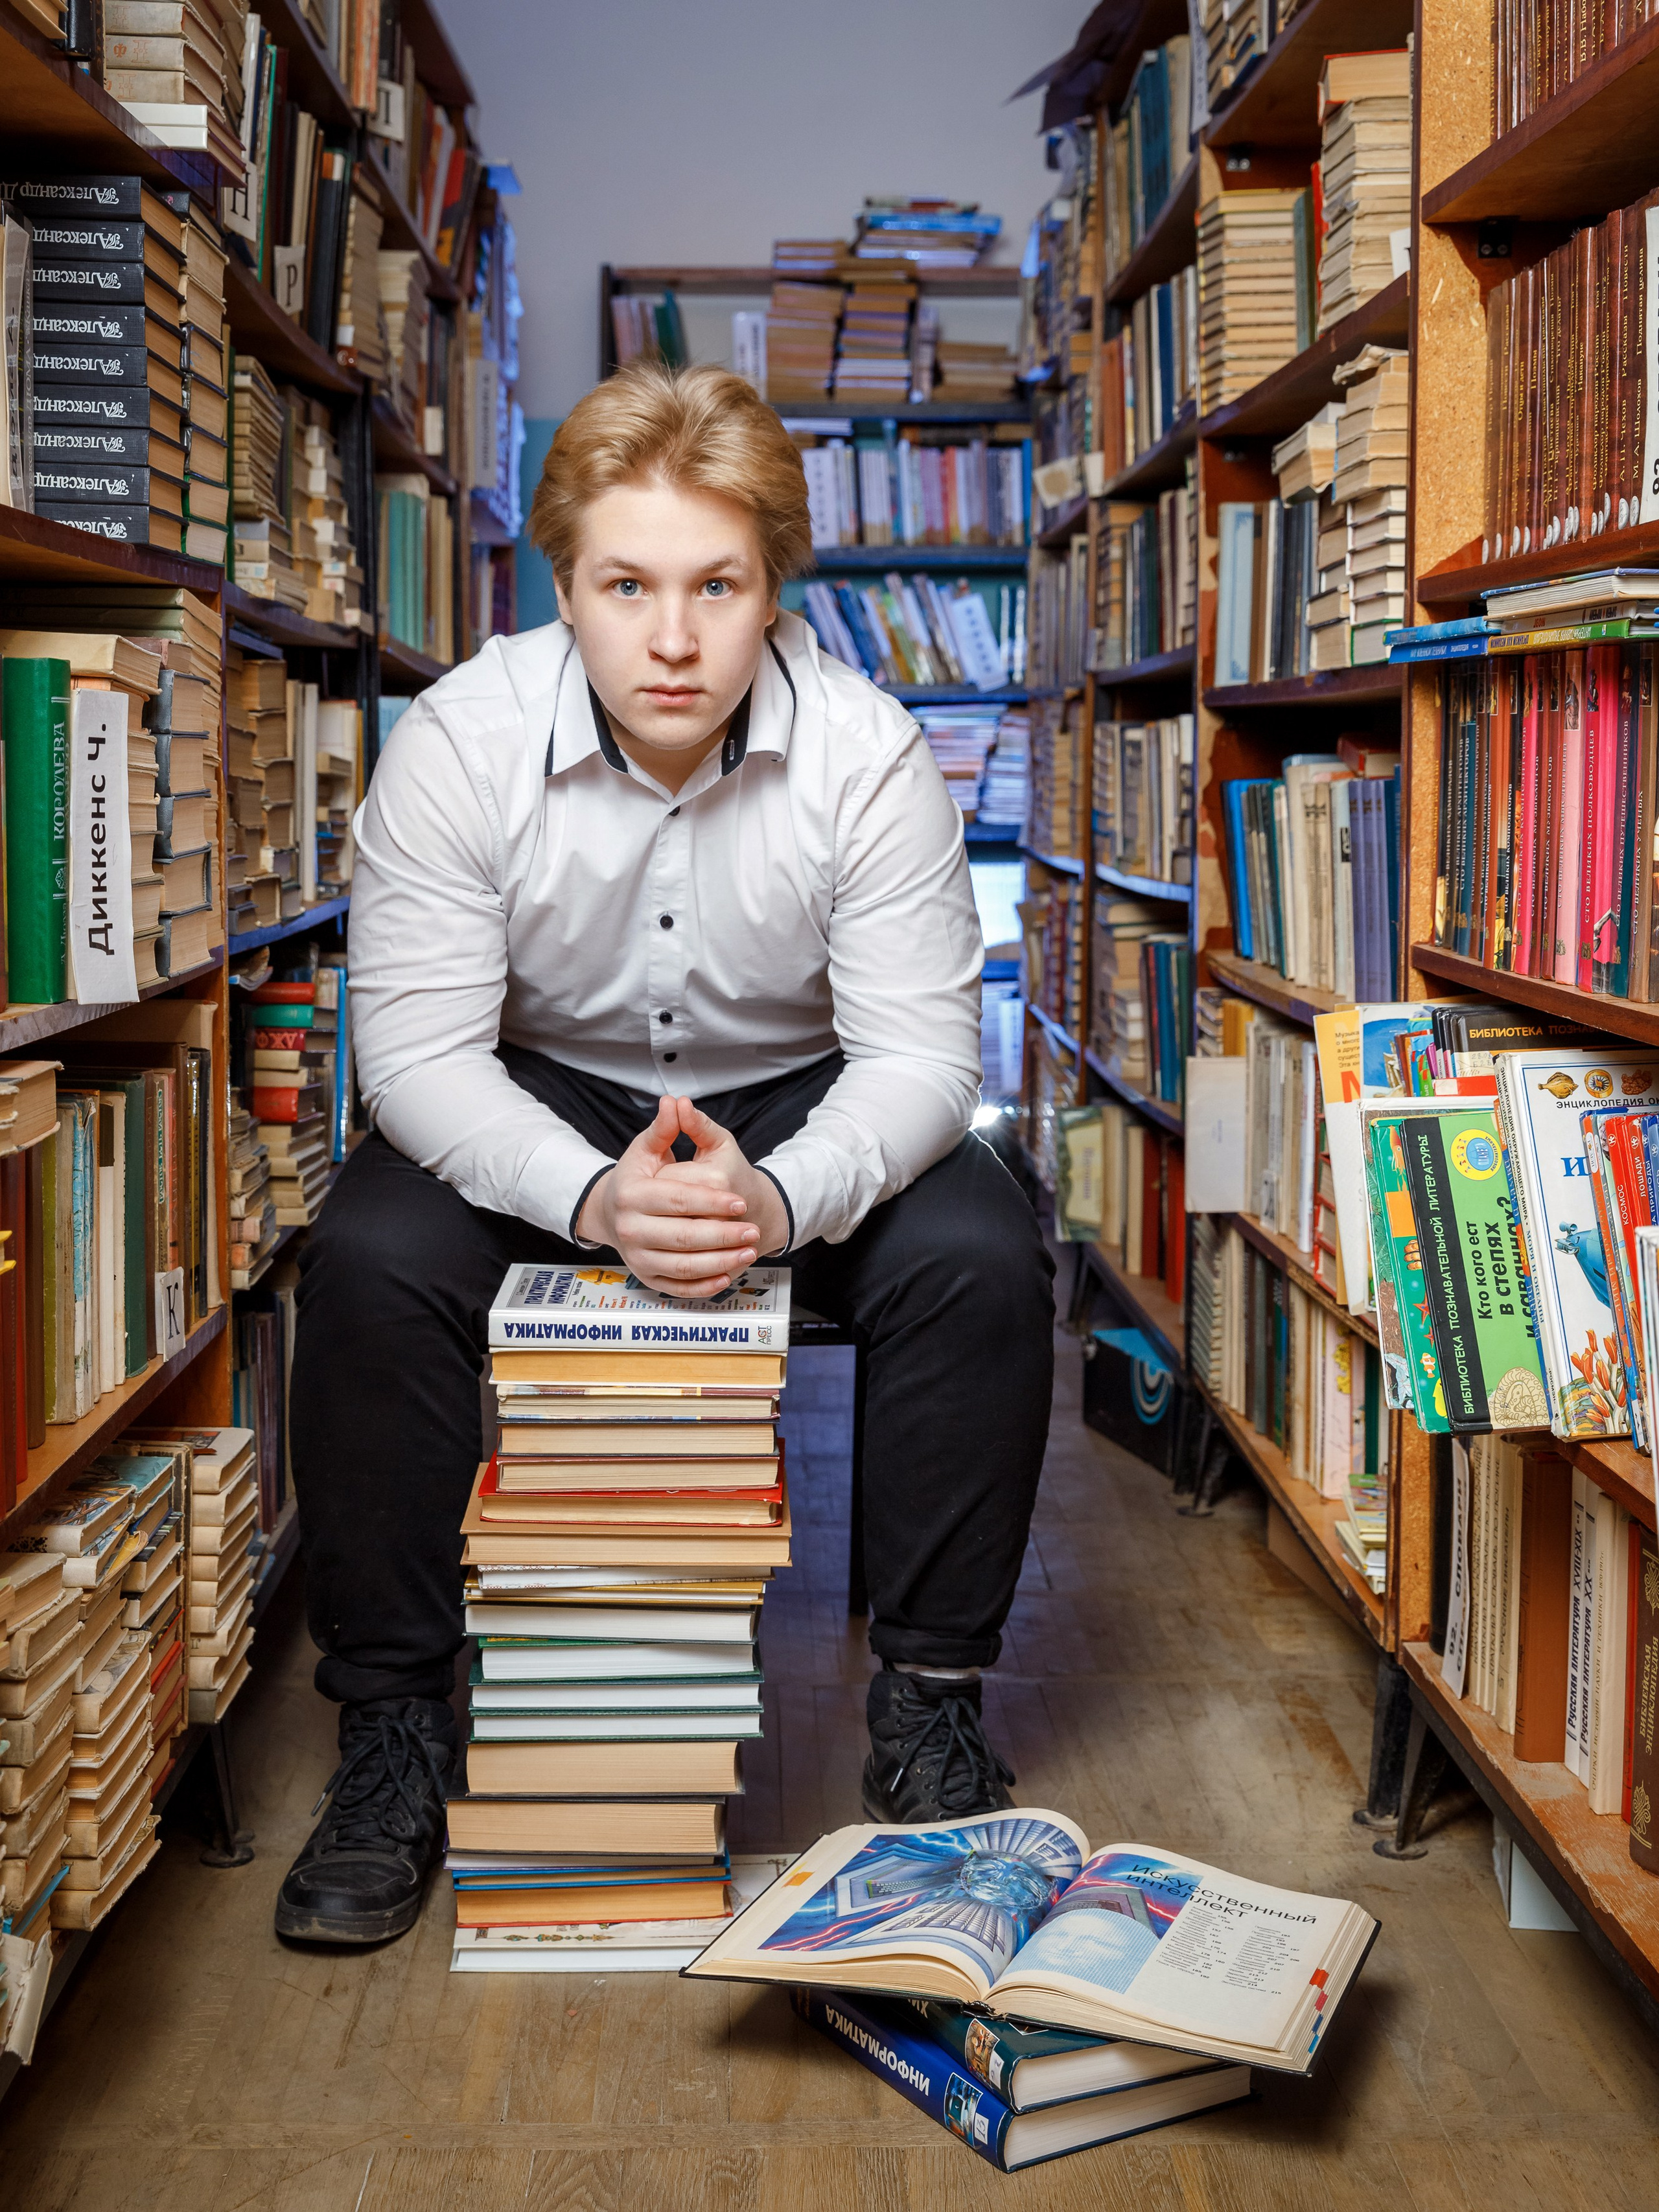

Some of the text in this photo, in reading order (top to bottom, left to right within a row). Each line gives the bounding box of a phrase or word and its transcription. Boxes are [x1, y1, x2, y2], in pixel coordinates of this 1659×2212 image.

[33, 228, 124, 251] Александ
[33, 268, 122, 290] Александ
[33, 317, 123, 338] Александ
[1636, 294, 1644, 356] Поднятая
[34, 354, 124, 376] Александ
[34, 396, 127, 418] Александ
[1634, 378, 1642, 438] Шолохов
[34, 432, 126, 453] Александ
[1633, 441, 1640, 457] А.
[1632, 459, 1640, 479] М.
[53, 720, 65, 842] КОРОЛЕВА
[1586, 729, 1595, 828] ПОЛКОВОДЦЕВ
[1619, 720, 1629, 845] ПУТЕШЕСТВЕННИКОВ
[87, 723, 115, 956] Диккенс Ч.
[1616, 848, 1625, 900] ВЕЛИКИХ
[1468, 1026, 1543, 1039] БИБЛИОТЕКА
[1555, 1098, 1645, 1110] ЭНЦИКЛОПЕДИЯ
[1500, 1067, 1514, 1133] ЭНЦИКЛОПЕДИЯ
[1511, 1134, 1524, 1196] ОКРУЖАЮЩЕГО
[1533, 1276, 1544, 1324] ОКЕАНЫ
[1634, 1156, 1647, 1197] ЛОШАДИ
[1644, 1160, 1655, 1212] ПРИРОДЫ
[1617, 1184, 1630, 1226] КОСМОС
[523, 1270, 555, 1305] ПРАКТИЧЕСКАЯ
[547, 1272, 575, 1304] ИНФОРМАТИКА
[1417, 1135, 1476, 1414] БИБЛИОТЕКА ПОЗНАВАТЕЛЬНОЙ ЛИТЕРАТУРЫ
[1465, 1221, 1494, 1320] Кто кого ест
[1483, 1221, 1515, 1316] в степях
[166, 1282, 180, 1340] К
[504, 1322, 749, 1343] ПРАКТИЧЕСКАЯ ИНФОРМАТИКА
[1584, 1576, 1593, 1604] XX
[1570, 1595, 1581, 1672] ЛИТЕРАТУРА
[1582, 1606, 1592, 1685] ЛИТЕРАТУРА
[1639, 1644, 1653, 1738] БИБЛЕЙСКАЯ
[1645, 1636, 1659, 1756] ЭНЦИКЛОПЕДИЯ
[1125, 1874, 1248, 1918] интеллект
[1131, 1864, 1317, 1924] Искусственный
[825, 2004, 931, 2097] ИНФОРМАТИКА
